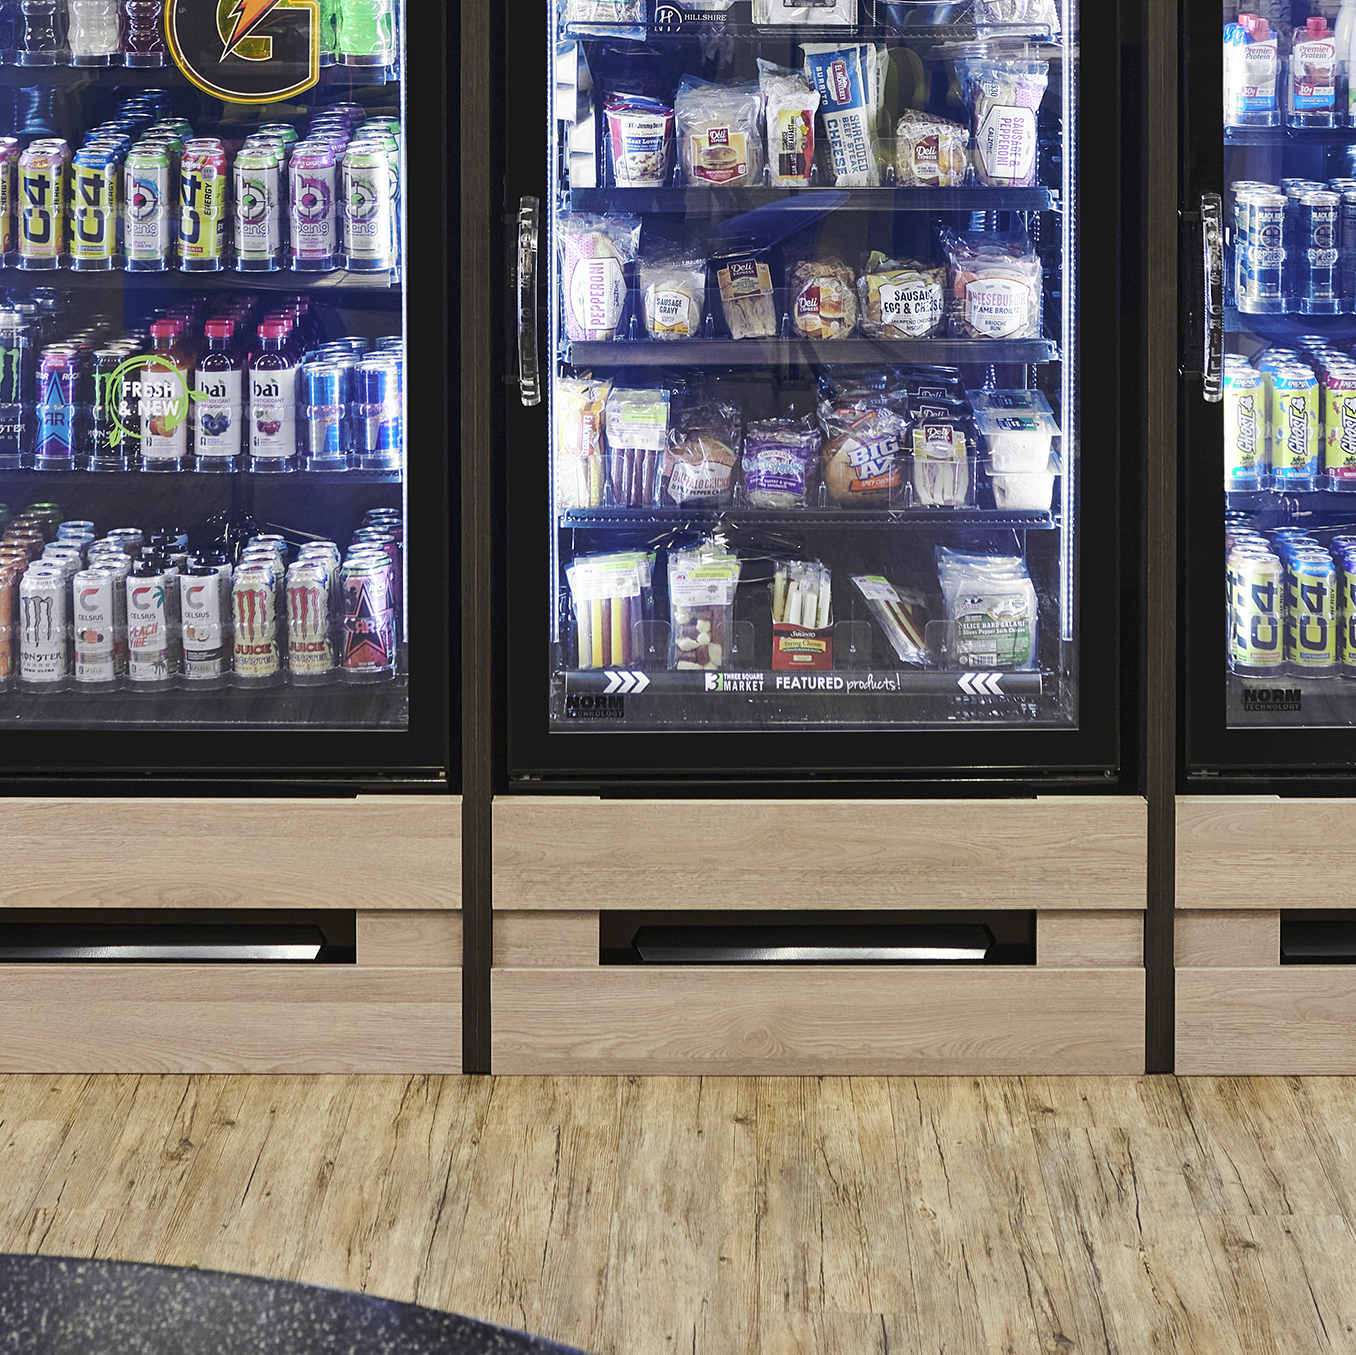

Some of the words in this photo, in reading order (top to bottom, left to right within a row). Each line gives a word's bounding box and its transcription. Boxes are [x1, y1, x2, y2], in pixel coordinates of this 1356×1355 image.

[1245, 47, 1273, 55] Premier
[1300, 46, 1329, 54] Premier
[1301, 52, 1327, 60] Protein
[816, 65, 828, 106] BURRITO
[842, 116, 852, 139] BEEF
[849, 114, 869, 172] SHREDDED
[998, 117, 1011, 167] PEPPERONI
[1013, 117, 1022, 158] SAUSAGE
[826, 118, 848, 175] CHEESE
[916, 145, 937, 156] Deli
[846, 141, 858, 174] STEAK
[204, 182, 213, 216] ENERGY
[23, 174, 50, 243] C4
[77, 174, 105, 243] C4
[295, 221, 329, 236] bang
[731, 263, 753, 273] Deli
[589, 262, 606, 326] PEPPERONI
[656, 298, 682, 307] SAUSAGE
[798, 298, 818, 307] Deli
[659, 306, 678, 315] GRAVY
[904, 303, 912, 314] &
[122, 381, 176, 399] FRESH
[254, 380, 278, 397] bai
[119, 402, 130, 416] &
[138, 401, 180, 417] NEW
[1237, 406, 1257, 455] GHOST
[1288, 406, 1308, 455] GHOST
[848, 437, 899, 467] BIG
[859, 455, 894, 480] AZ
[861, 478, 874, 487] SPICY
[1251, 581, 1278, 650] C4
[1300, 581, 1328, 651] C4
[235, 643, 272, 654] JUICE
[289, 641, 326, 652] JUICE
[784, 641, 801, 649] String
[802, 640, 822, 648] Cheese
[724, 681, 764, 691] MARKET
[776, 676, 843, 689] FEATURED
[846, 673, 901, 694] products!
[567, 696, 624, 709] NORM
[1245, 689, 1301, 701] NORM
